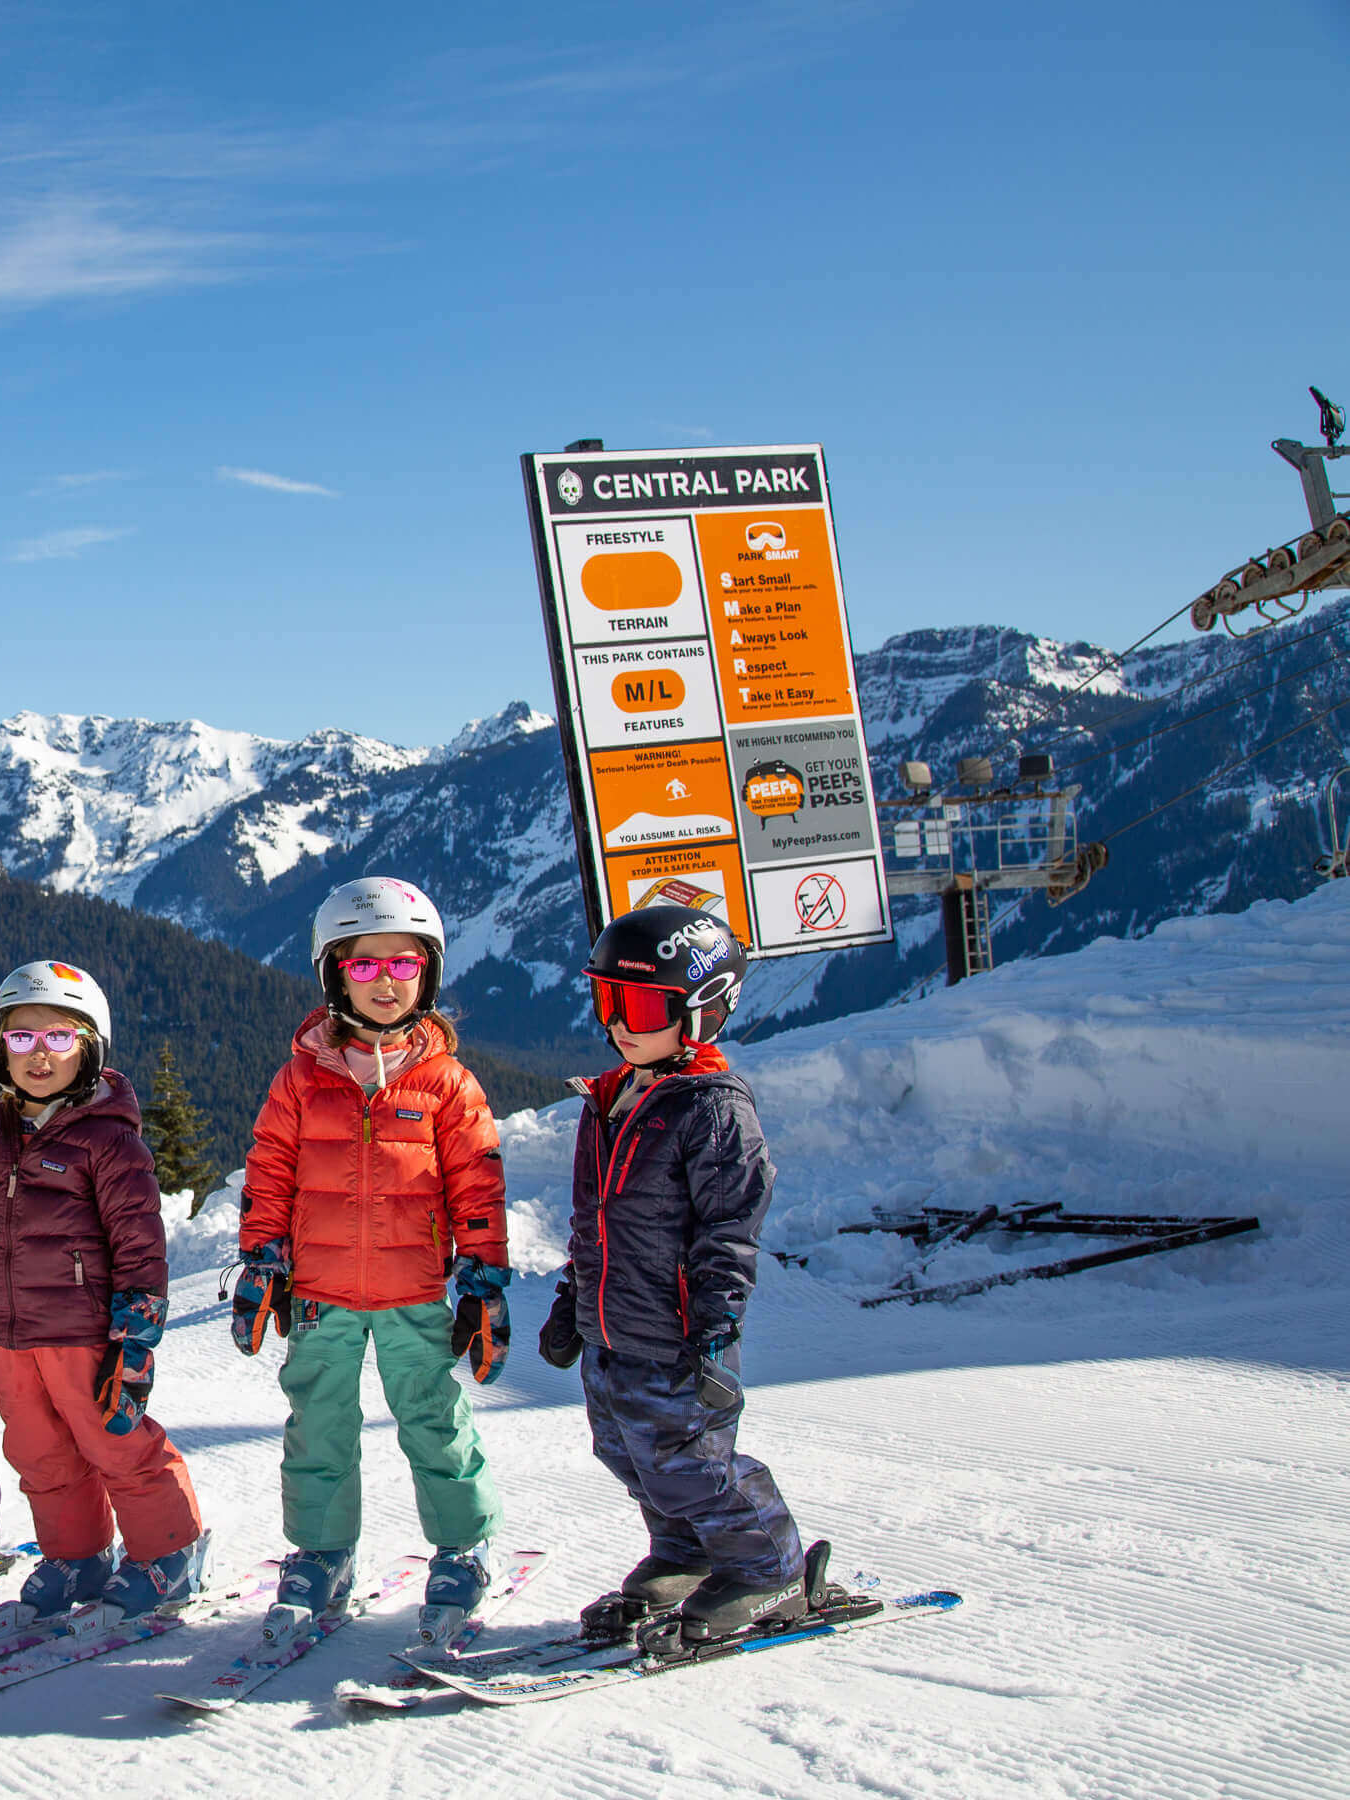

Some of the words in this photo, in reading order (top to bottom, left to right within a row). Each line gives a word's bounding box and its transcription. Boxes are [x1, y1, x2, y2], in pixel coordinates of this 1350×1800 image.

[593, 471, 728, 500] CENTRAL
[734, 467, 810, 493] PARK
[586, 530, 665, 545] FREESTYLE
[738, 552, 764, 561] PARK
[765, 549, 800, 560] SMART
[720, 572, 755, 588] Start
[758, 573, 791, 585] Small
[724, 600, 761, 616] Make
[765, 605, 772, 613] a
[776, 602, 801, 613] Plan
[608, 616, 668, 631] TERRAIN
[730, 629, 776, 644] Always
[779, 629, 808, 641] Look
[582, 654, 609, 665] THIS
[612, 651, 643, 663] PARK
[647, 646, 705, 660] CONTAINS
[733, 658, 787, 674] Respect
[738, 687, 771, 703] Take
[775, 689, 784, 700] it
[787, 688, 814, 700] Easy
[624, 717, 684, 732] FEATURES
[736, 738, 750, 748] WE
[752, 735, 782, 746] HIGHLY
[784, 730, 835, 744] RECOMMEND
[837, 729, 854, 739] YOU
[635, 750, 681, 761] WARNING!
[596, 766, 625, 774] Serious
[626, 763, 655, 772] Injuries
[666, 759, 689, 767] Death
[691, 756, 721, 765] Possible
[805, 760, 825, 773] GET
[827, 758, 859, 771] YOUR
[810, 790, 864, 808] PASS
[619, 834, 638, 843] YOU
[640, 830, 675, 841] ASSUME
[678, 828, 694, 837] ALL
[696, 825, 721, 835] RISKS
[771, 831, 860, 850] MyPeepsPass.com
[645, 851, 701, 865] ATTENTION
[631, 867, 652, 877] STOP
[671, 863, 690, 872] SAFE
[692, 860, 717, 870] PLACE
[657, 917, 717, 960] OAKLEY
[749, 1583, 802, 1618] HEAD
